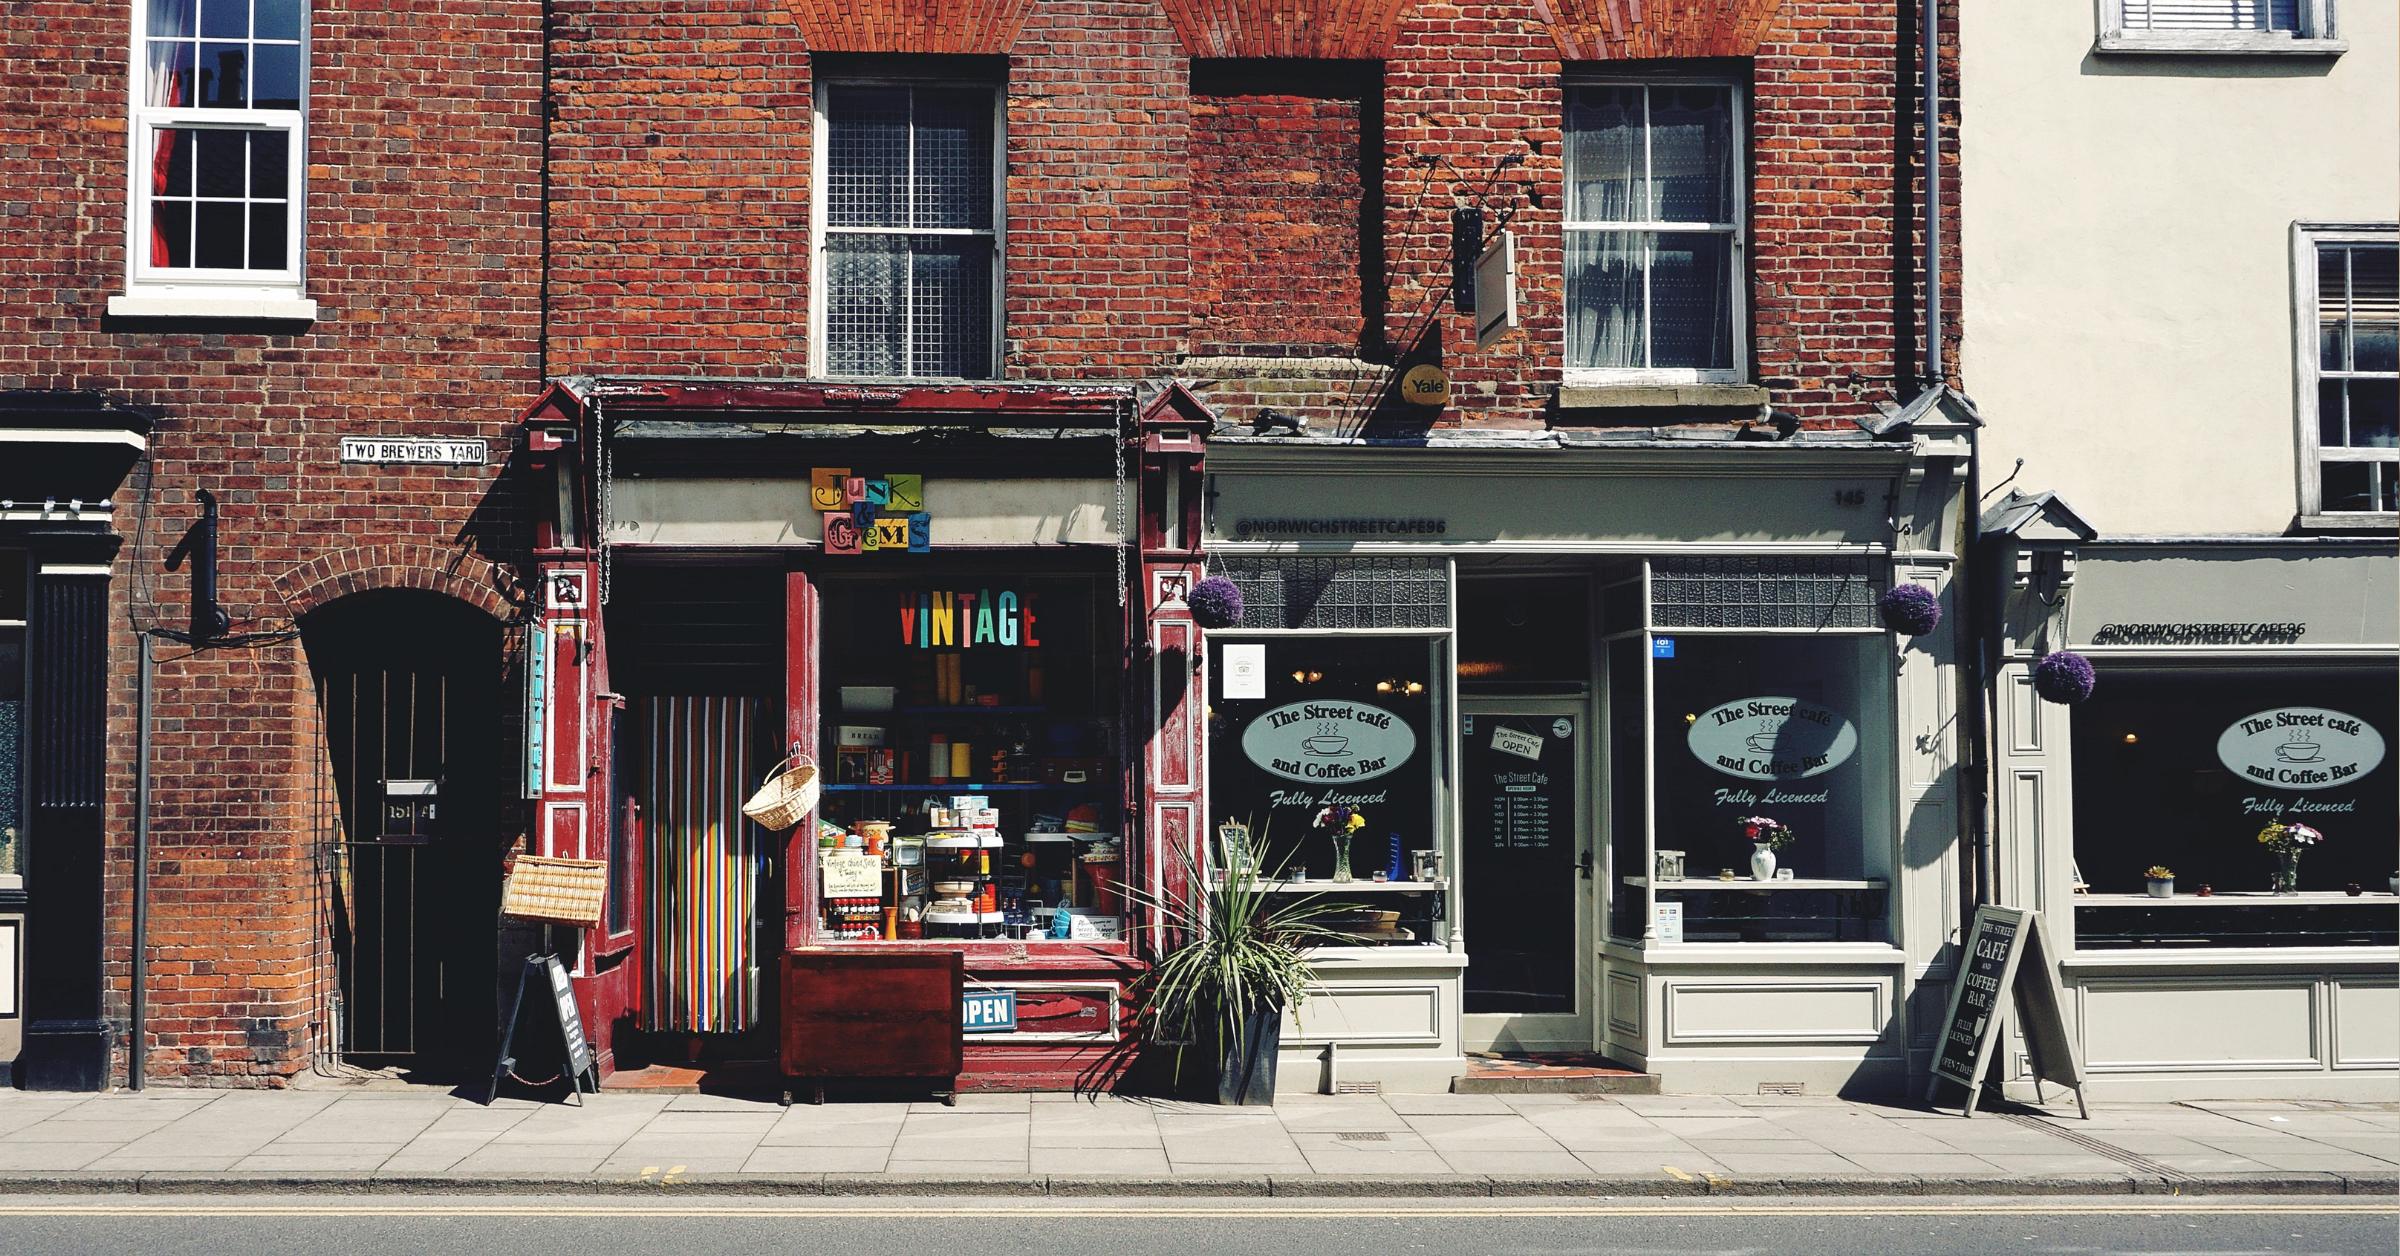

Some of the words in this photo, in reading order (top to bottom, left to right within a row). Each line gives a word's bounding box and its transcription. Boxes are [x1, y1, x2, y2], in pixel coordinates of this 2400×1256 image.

[1412, 380, 1444, 393] Yale
[345, 443, 375, 458] TWO
[381, 443, 442, 459] BREWERS
[450, 445, 482, 460] YARD
[1835, 490, 1865, 506] 145
[857, 502, 873, 525] &
[1235, 519, 1446, 536] @NORWICHSTREETCAFE96
[899, 589, 1040, 648] VINTAGE
[2100, 623, 2306, 638] @NORWICHSTREETCAFE96
[1267, 711, 1300, 729] The
[1304, 704, 1354, 720] Street
[1357, 711, 1391, 730] café
[1712, 708, 1744, 726] The
[1748, 701, 1795, 717] Street
[2240, 718, 2272, 736] The
[2276, 712, 2324, 727] Street
[2328, 719, 2361, 736] café
[1509, 732, 1527, 742] Street
[1502, 740, 1531, 754] OPEN
[1271, 758, 1301, 775] and
[1304, 763, 1356, 778] Coffee
[1357, 756, 1386, 774] Bar
[1716, 755, 1745, 772] and
[1749, 760, 1799, 774] Coffee
[1803, 753, 1828, 771] Bar
[1494, 774, 1507, 784] The
[1508, 772, 1531, 783] Street
[2247, 764, 2275, 781] and
[2279, 769, 2328, 783] Coffee
[2330, 762, 2358, 780] Bar
[1270, 790, 1313, 808] Fully
[1318, 789, 1387, 804] Licenced
[1714, 788, 1757, 807] Fully
[1761, 788, 1828, 803] Licenced
[2242, 797, 2285, 815] Fully
[2289, 797, 2355, 812] Licenced
[390, 805, 410, 818] 151
[1982, 923, 1994, 933] THE
[1995, 925, 2016, 937] STREET
[1976, 939, 2008, 961] CAFÉ
[1966, 973, 1998, 992] COFFEE
[1967, 991, 1986, 1007] BAR
[1957, 1018, 1973, 1031] FULLY
[1949, 1030, 1973, 1046] LICENCED
[1942, 1057, 1955, 1068] OPEN
